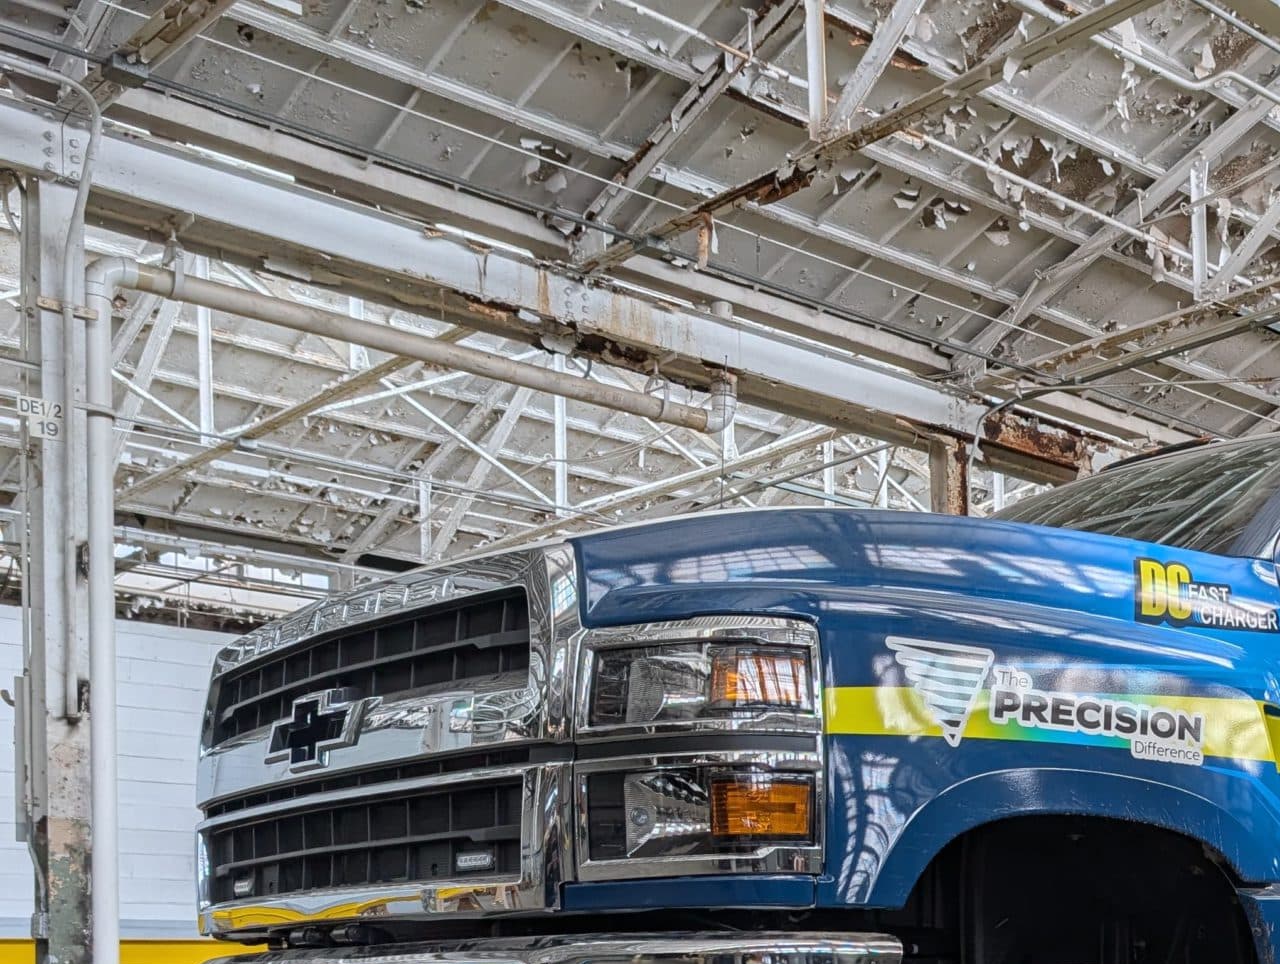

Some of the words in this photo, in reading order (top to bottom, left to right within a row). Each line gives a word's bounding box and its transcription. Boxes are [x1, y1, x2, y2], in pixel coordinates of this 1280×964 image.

[20, 398, 62, 418] DE1/2
[37, 421, 59, 437] 19
[1138, 558, 1193, 620] DC
[1188, 583, 1229, 602] FAST
[1200, 605, 1279, 631] CHARGER
[999, 670, 1028, 689] The
[993, 691, 1201, 743] PRECISION
[1133, 740, 1201, 762] Difference
